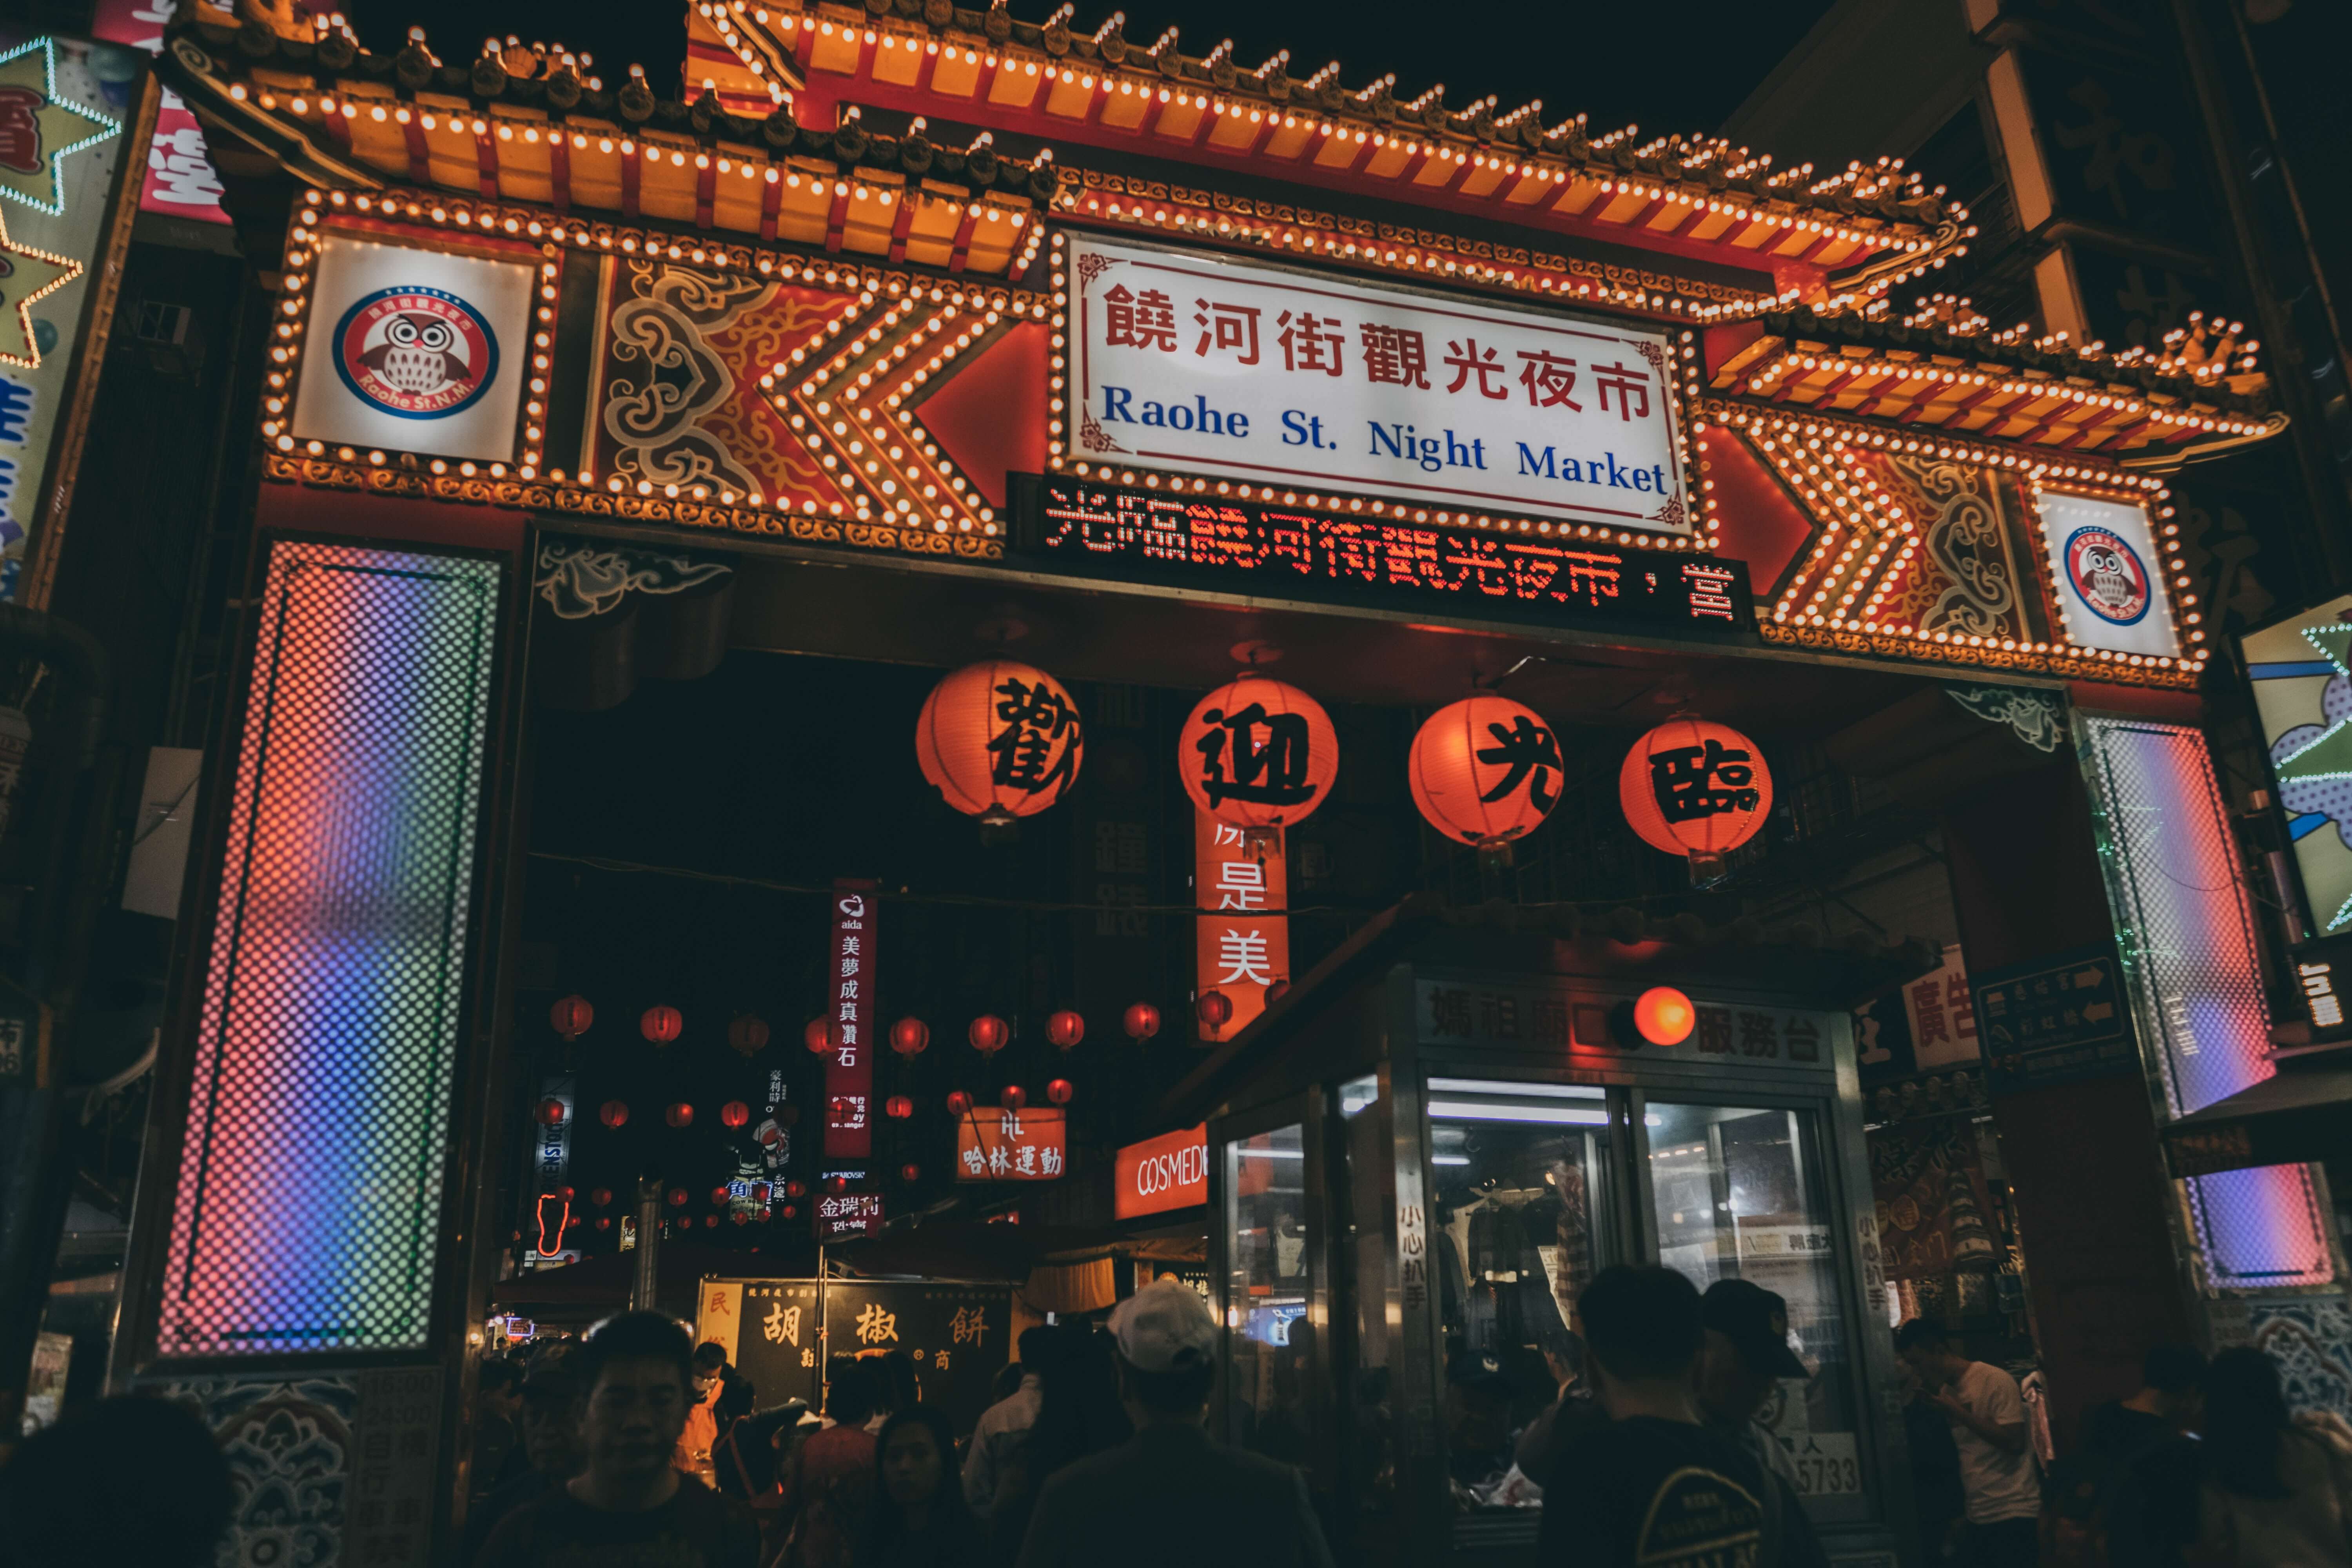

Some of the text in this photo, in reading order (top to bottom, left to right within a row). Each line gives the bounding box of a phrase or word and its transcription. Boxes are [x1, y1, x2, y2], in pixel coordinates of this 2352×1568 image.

[368, 297, 473, 331] 饒河街觀光夜市
[1103, 282, 1651, 422] 饒河街觀光夜市
[359, 374, 411, 408] Raohe
[1101, 384, 1667, 496] Raohe St. Night Market
[987, 678, 1083, 793] 歡
[1196, 703, 1316, 809] 迎
[1477, 715, 1563, 815] 光
[1648, 739, 1760, 824] 臨
[841, 920, 862, 929] aida
[962, 1145, 1062, 1176] 哈林運動
[1401, 1205, 1426, 1310] 小心扒手
[763, 1302, 990, 1348] 胡椒餅
[1797, 1458, 1857, 1492] 5733
